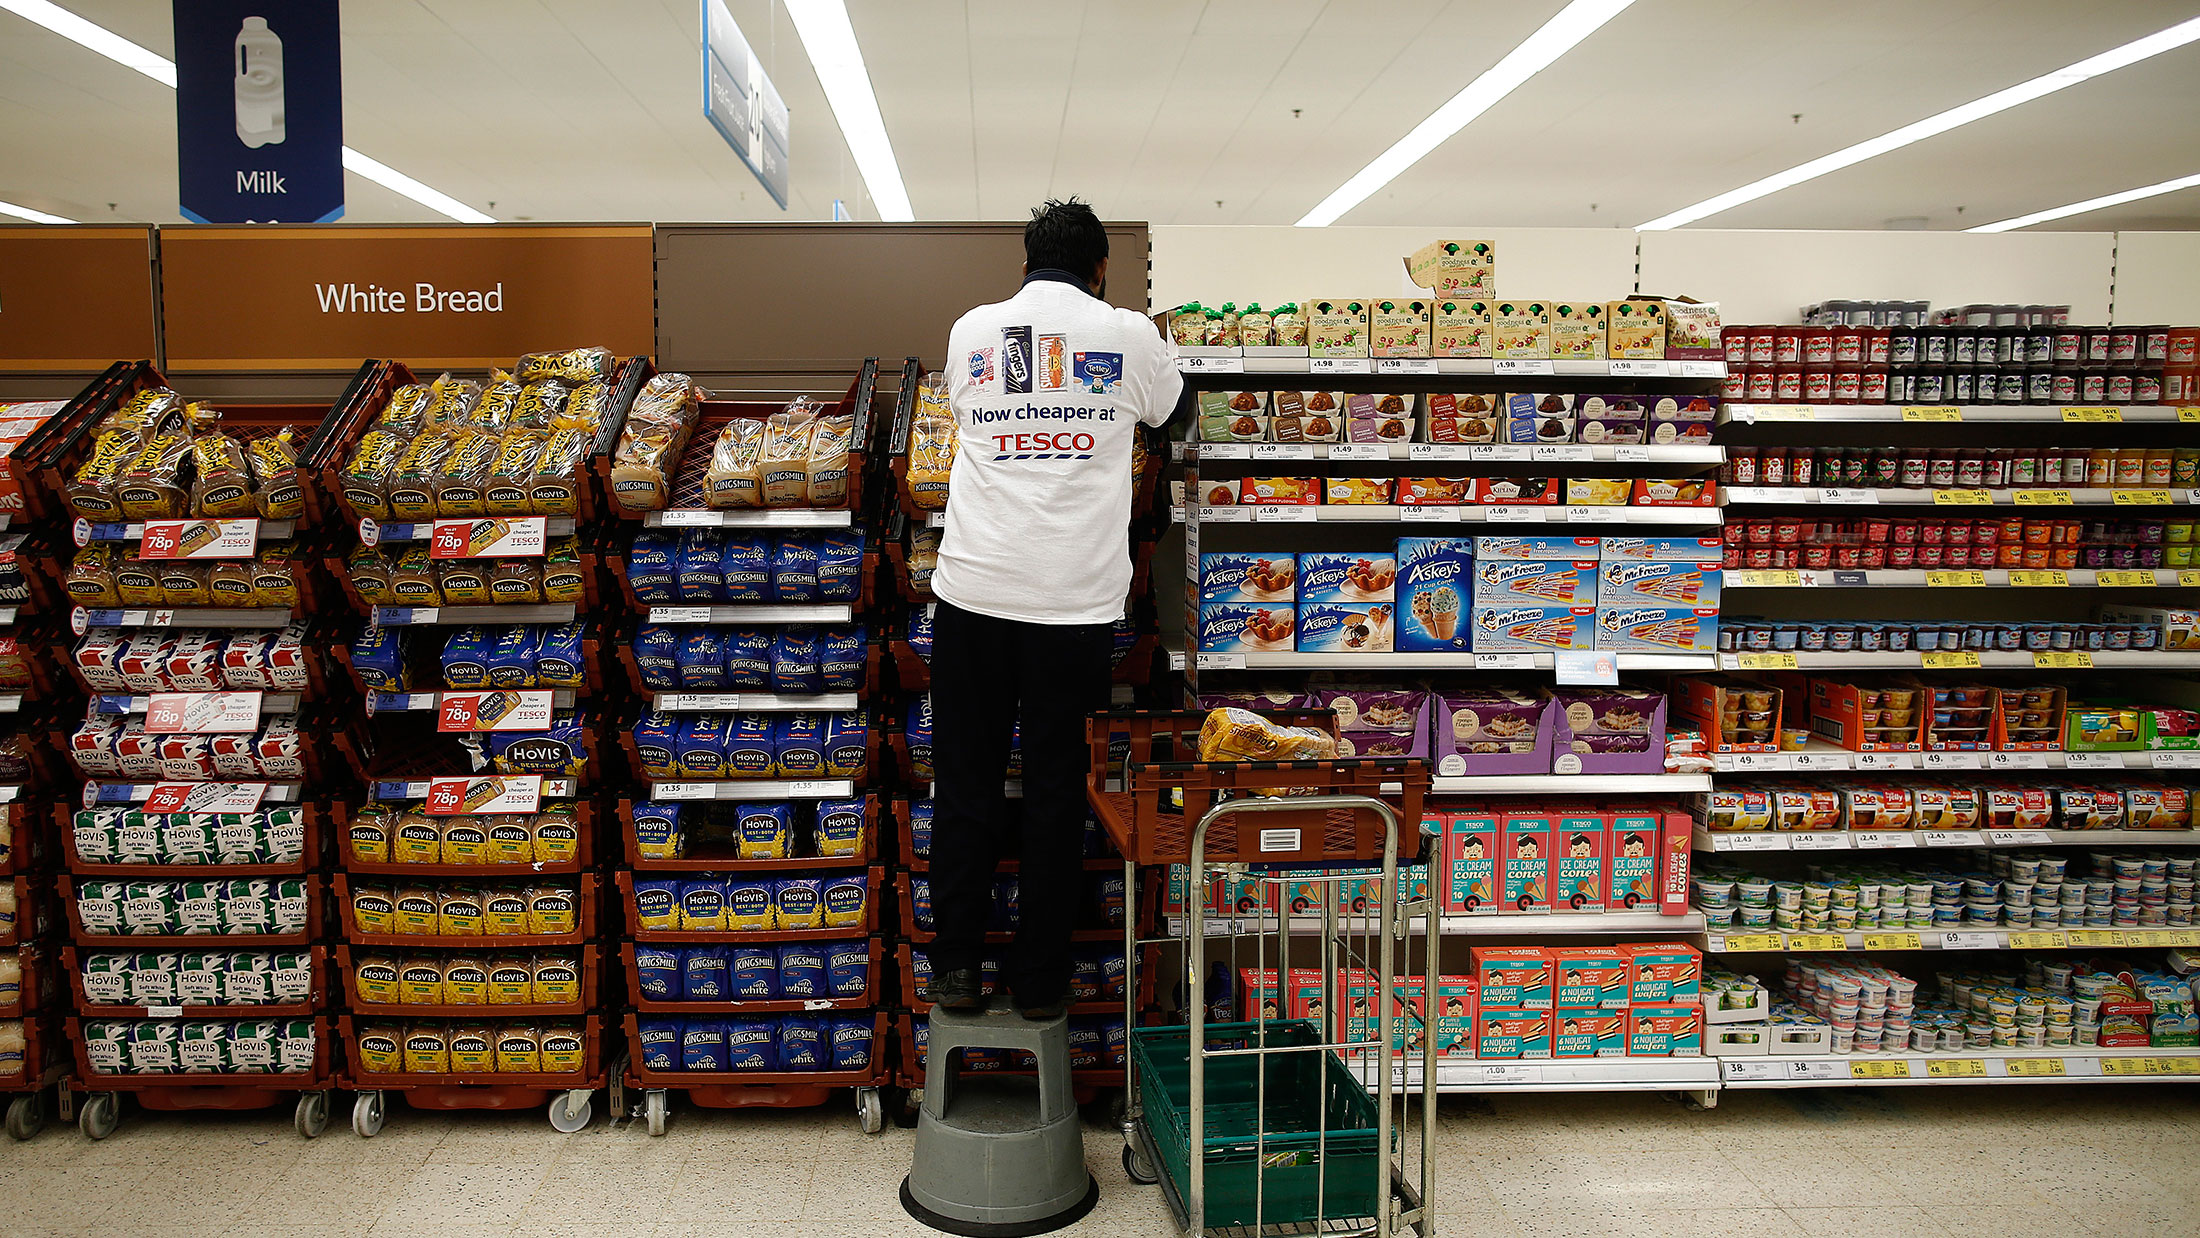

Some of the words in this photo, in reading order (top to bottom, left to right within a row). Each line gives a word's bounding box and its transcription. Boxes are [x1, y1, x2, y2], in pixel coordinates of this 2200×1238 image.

[236, 171, 287, 194] Milk
[315, 283, 406, 313] White
[415, 282, 503, 313] Bread
[1006, 341, 1026, 380] fingers
[1087, 364, 1110, 374] Tetley
[971, 407, 1012, 425] Now
[1014, 403, 1095, 423] cheaper
[1099, 407, 1116, 422] at
[992, 432, 1095, 452] TESCO
[766, 472, 806, 484] KINGSMILL
[615, 480, 655, 491] KINGSMILL
[147, 536, 174, 551] 78p
[436, 535, 463, 550] 78p
[1536, 541, 1547, 550] 20
[633, 555, 668, 564] white
[680, 574, 721, 584] KINGSMILL
[726, 572, 768, 584] KINGSMILL
[1414, 583, 1423, 591] 21
[1423, 581, 1437, 590] Cup
[1480, 586, 1492, 594] 20
[1605, 586, 1617, 595] 20
[2169, 613, 2193, 625] Dole
[682, 665, 723, 675] KINGSMILL
[822, 662, 861, 673] KINGSMILL
[153, 709, 179, 724] 78p
[225, 711, 253, 719] TESCO
[445, 708, 471, 722] 78p
[153, 793, 180, 807] 78p
[433, 792, 458, 806] 78p
[1713, 795, 1737, 807] Dole
[1783, 795, 1805, 807] Dole
[1853, 793, 1876, 804] Dole
[1993, 795, 2016, 804] Dole
[1453, 861, 1465, 871] ICE
[1466, 861, 1492, 871] CREAM
[1507, 861, 1519, 871] ICE
[1520, 860, 1546, 871] CREAM
[1454, 869, 1492, 880] cones
[1507, 869, 1546, 879] cones
[1453, 891, 1463, 900] 10
[1505, 890, 1517, 899] 10
[735, 956, 775, 970] KINGSMILL
[783, 955, 823, 968] KINGSMILL
[740, 985, 769, 996] white
[785, 985, 813, 995] white
[1483, 988, 1489, 996] 6
[1489, 987, 1517, 996] NOUGAT
[1561, 988, 1567, 996] 6
[1567, 987, 1595, 997] NOUGAT
[1483, 993, 1517, 1004] wafers
[1561, 993, 1595, 1004] wafers
[731, 1031, 770, 1044] KINGSMILL
[1558, 1037, 1565, 1045] 6
[1565, 1036, 1592, 1046] NOUGAT
[1558, 1043, 1591, 1053] wafers
